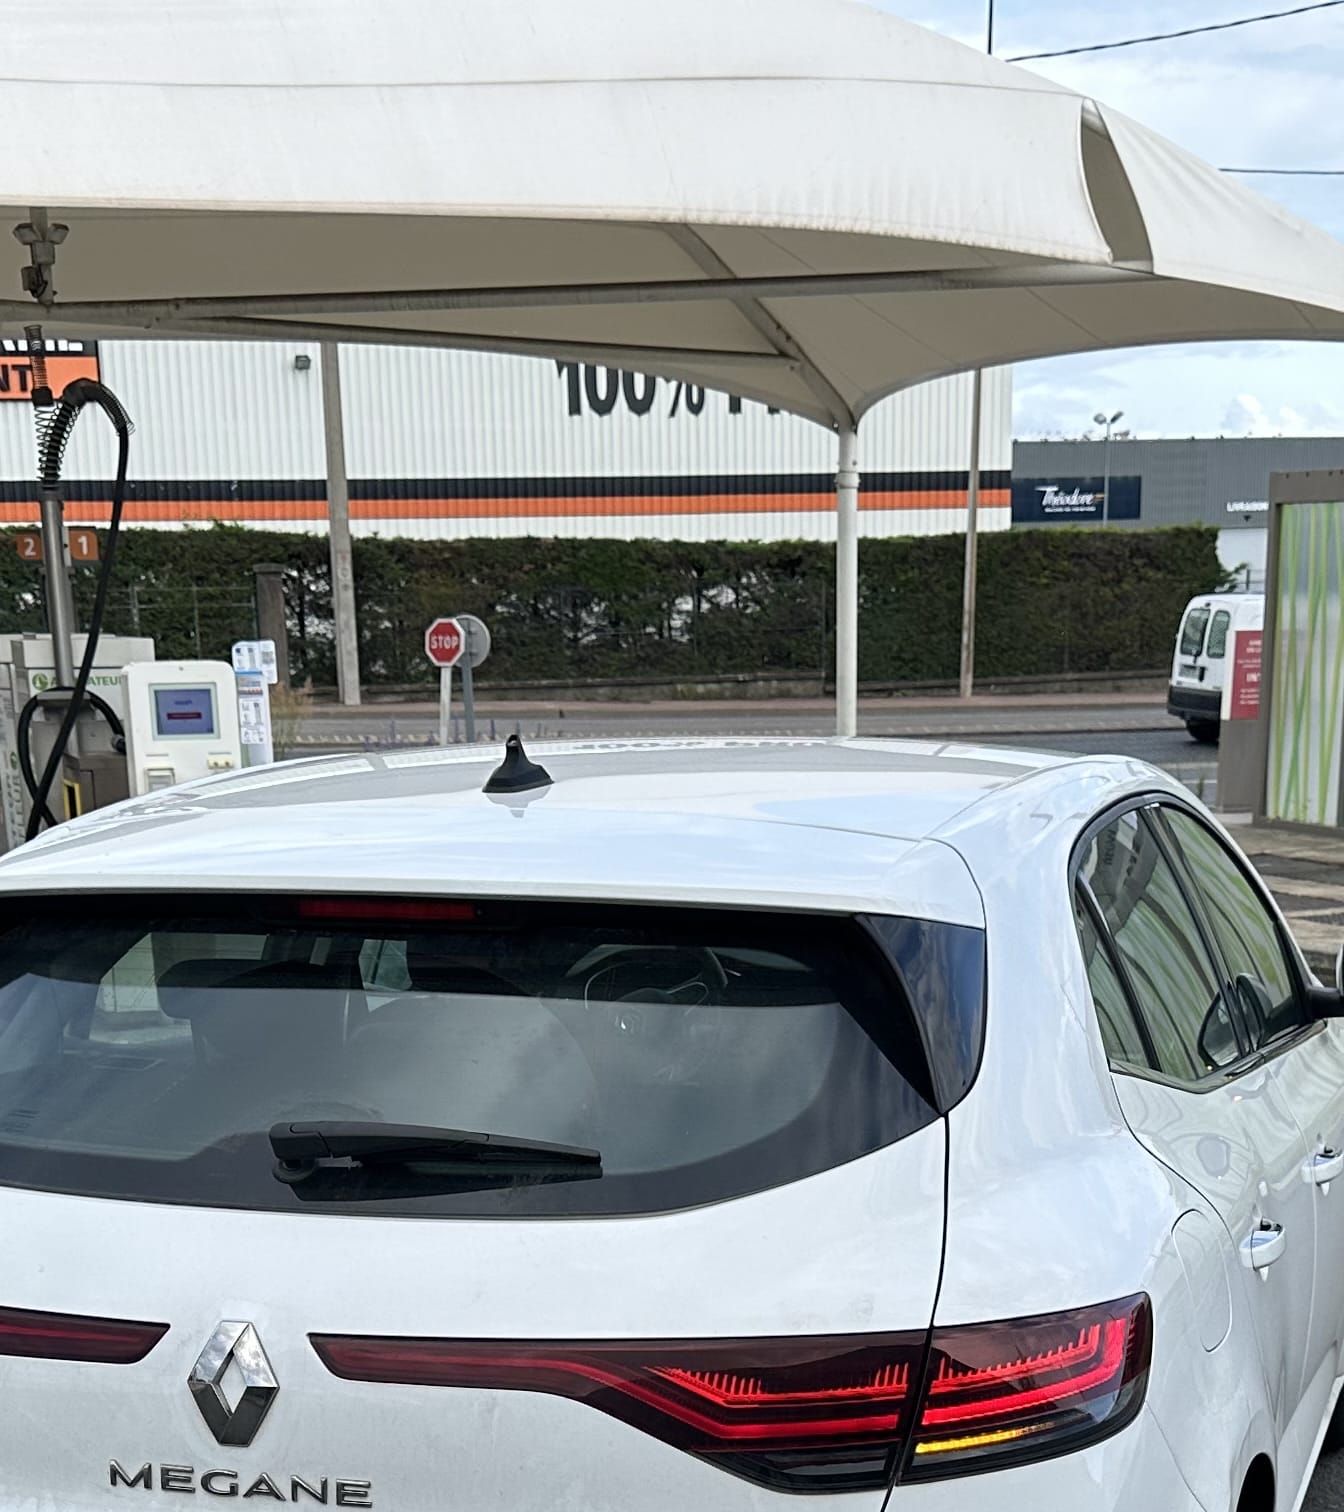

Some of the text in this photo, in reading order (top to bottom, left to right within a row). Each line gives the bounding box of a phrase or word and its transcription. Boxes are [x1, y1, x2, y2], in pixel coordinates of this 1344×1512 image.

[24, 538, 36, 556] 2
[77, 535, 88, 555] 1
[430, 634, 459, 649] STOP
[108, 1458, 373, 1508] MEGANE
